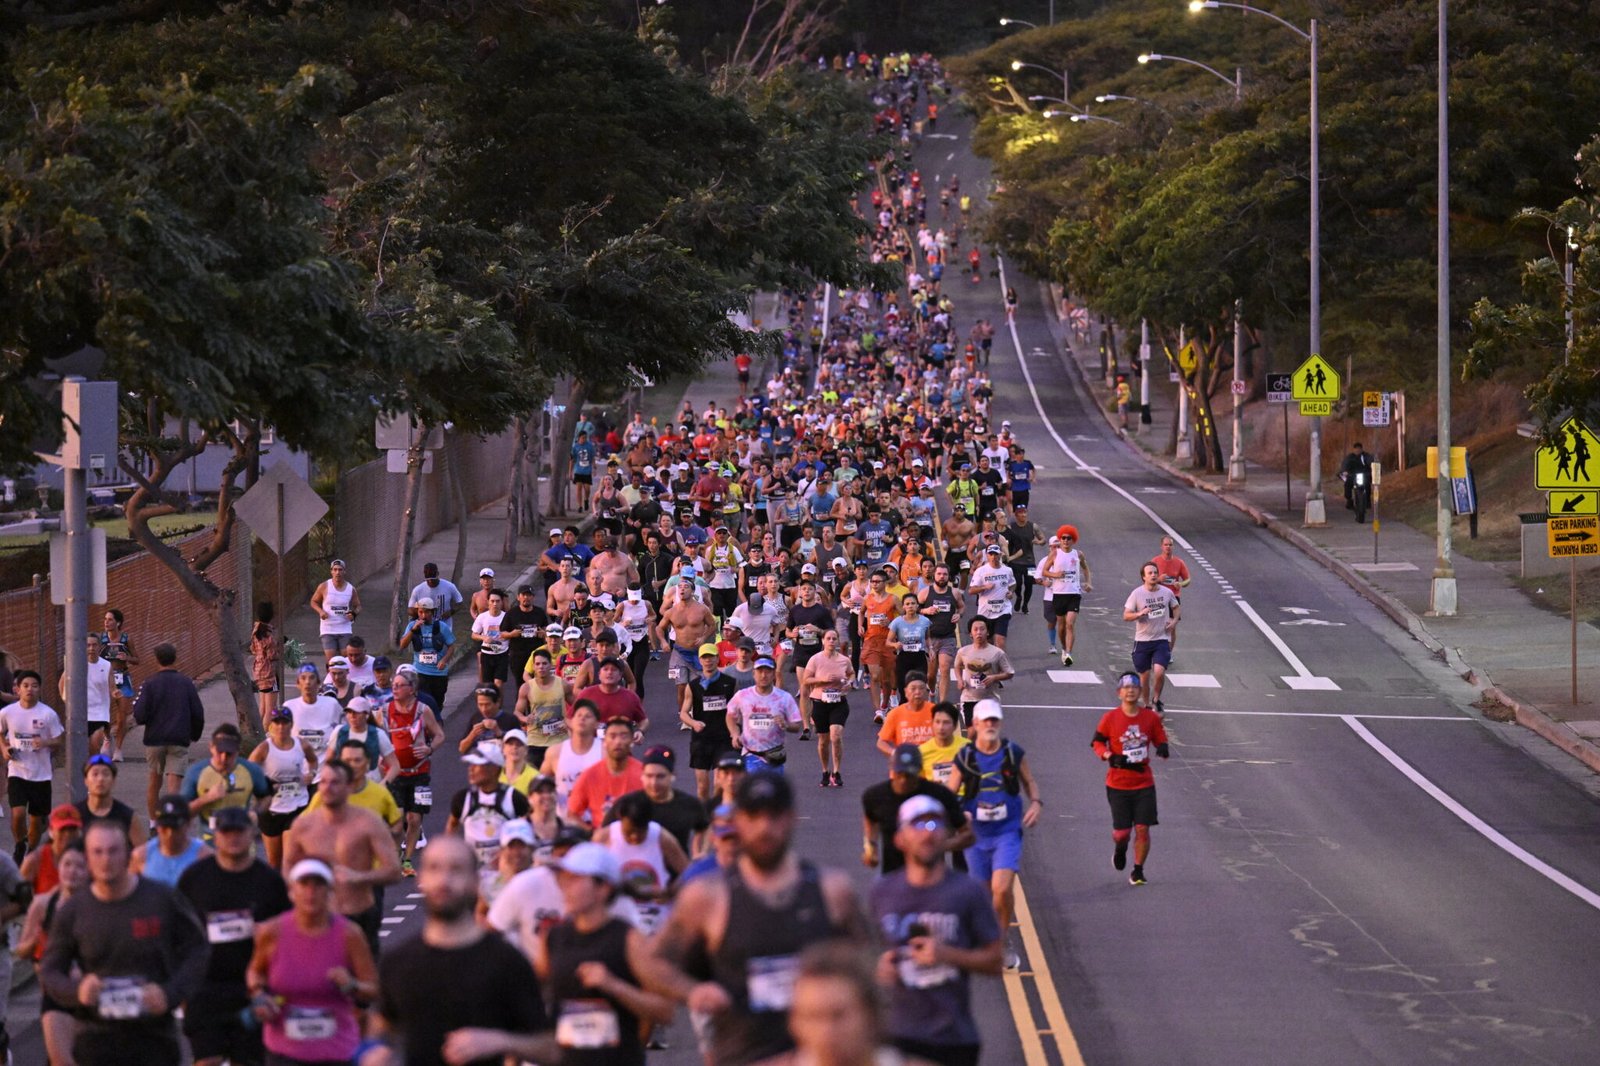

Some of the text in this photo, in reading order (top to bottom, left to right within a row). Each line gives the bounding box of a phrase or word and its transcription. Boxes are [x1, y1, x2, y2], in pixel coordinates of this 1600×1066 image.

[1268, 393, 1283, 401] BIKE
[1303, 404, 1328, 413] AHEAD
[1551, 518, 1596, 530] CREW PARKING
[1553, 544, 1597, 555] CREW PARKING
[901, 726, 933, 737] OSAKA
